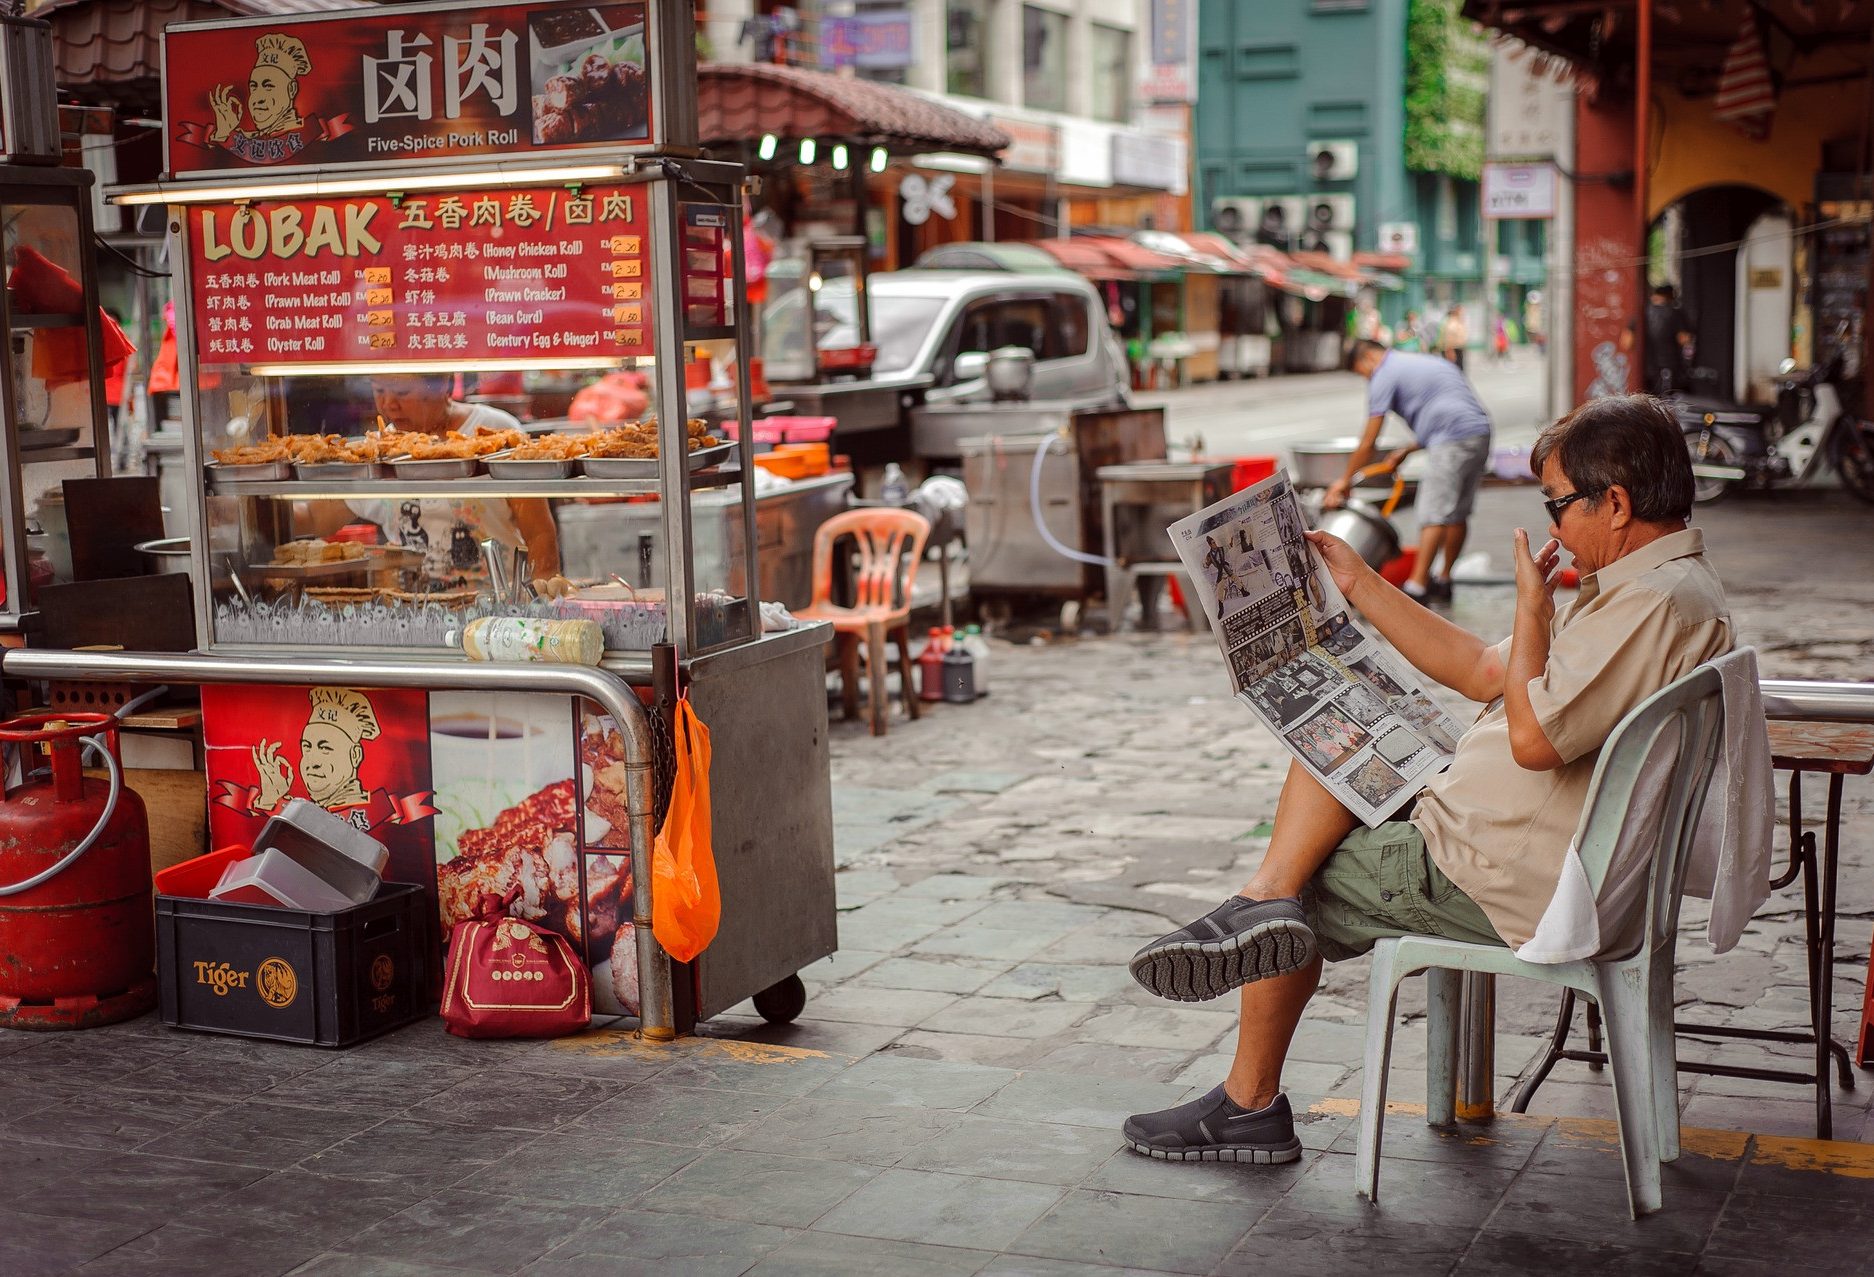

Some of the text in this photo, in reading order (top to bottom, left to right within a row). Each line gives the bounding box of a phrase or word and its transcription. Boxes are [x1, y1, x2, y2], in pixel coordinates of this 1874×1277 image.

[363, 23, 519, 123] 卤肉
[234, 132, 304, 159] 文记饮食
[368, 129, 518, 153] Five-Spice Pork Roll
[202, 202, 382, 261] LOBAK
[403, 241, 480, 260] 蜜汁鸡肉卷
[483, 239, 583, 259] (Honey Chicken Roll)
[264, 270, 341, 286] (Pork Meat Roll)
[404, 266, 450, 282] 冬菇卷
[484, 263, 567, 280] (Mushroom Roll)
[205, 273, 260, 289] 五香肉卷
[206, 294, 251, 310] 虾肉卷
[265, 291, 351, 308] (Prawn Meat Roll)
[405, 289, 436, 305] 虾饼
[485, 286, 566, 302] (Prawn Cracker)
[208, 316, 253, 332] 蟹肉卷
[266, 313, 343, 330] (Crab Meat Roll)
[406, 310, 467, 327] 五香豆腐
[486, 308, 543, 325] (Bean Curd)
[357, 335, 370, 345] RM
[407, 332, 468, 349] 皮蛋酸姜
[487, 331, 599, 349] (Century Egg & Ginger)
[603, 330, 616, 340] RM
[267, 336, 325, 353] (Oyster Roll)
[194, 961, 249, 996] Tiger
